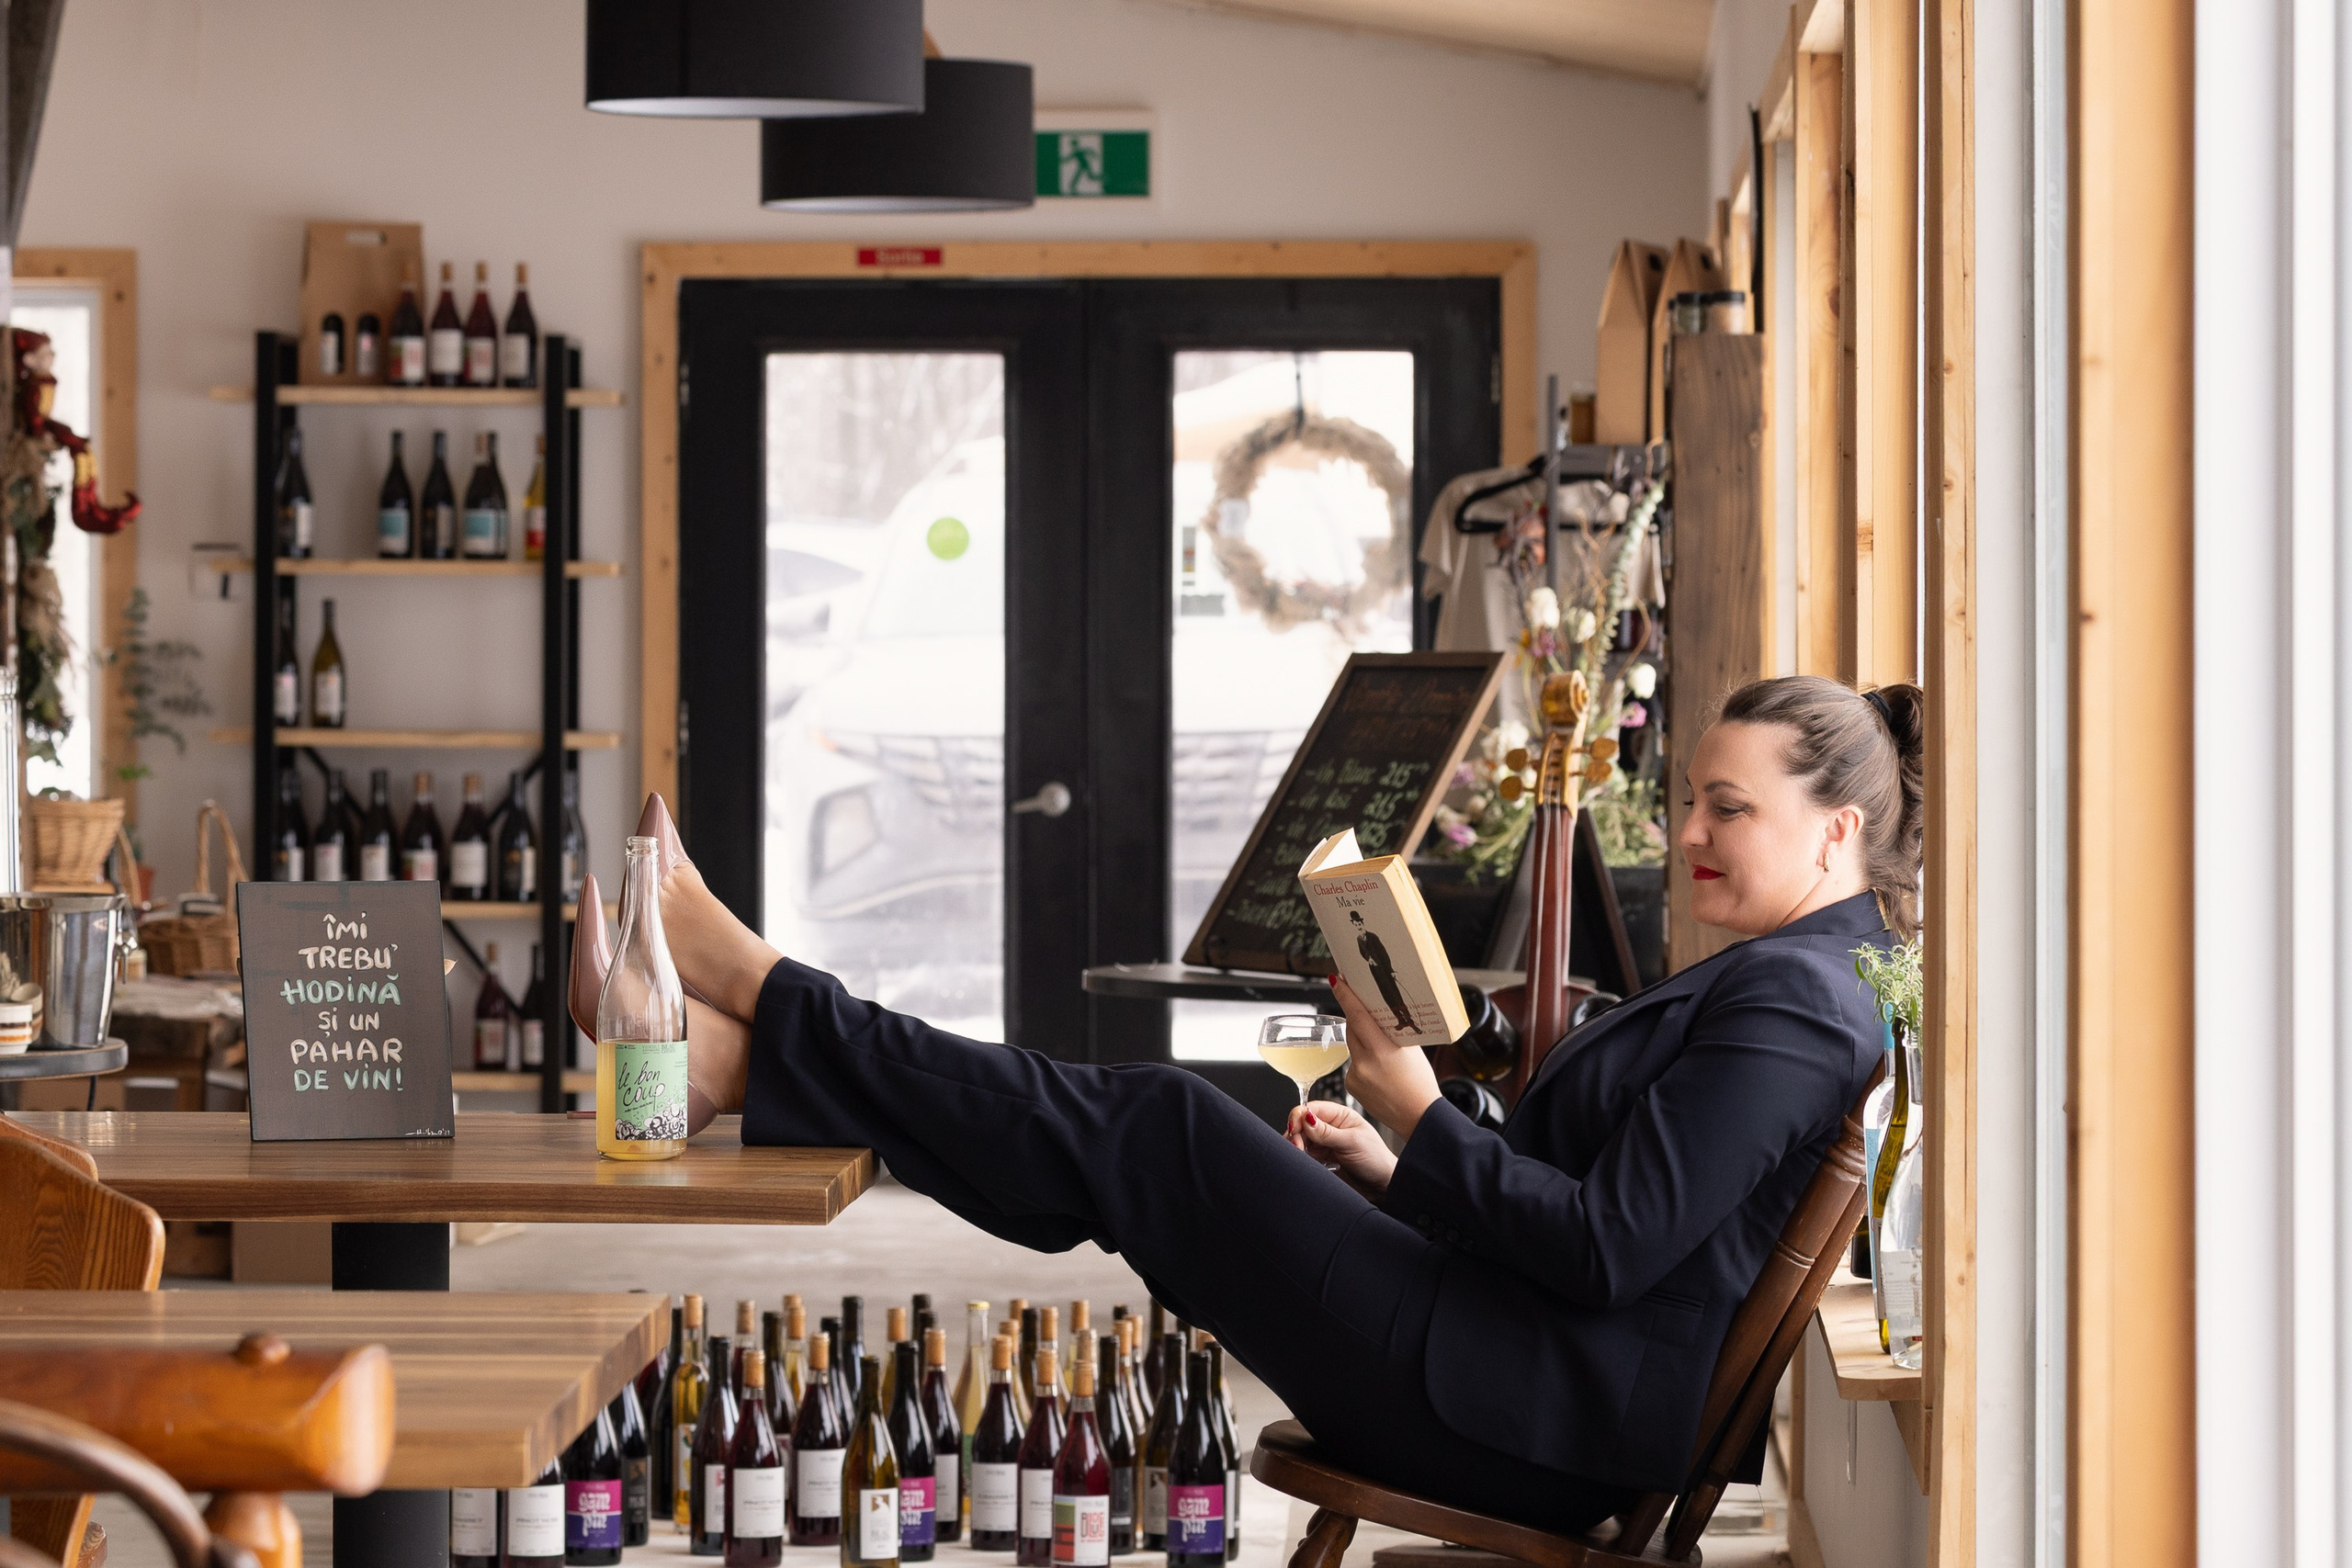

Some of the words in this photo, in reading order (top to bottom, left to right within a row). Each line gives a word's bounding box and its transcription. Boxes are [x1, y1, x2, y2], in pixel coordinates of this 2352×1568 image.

[1313, 882, 1344, 896] Charles
[1344, 878, 1379, 893] Chaplin
[1335, 896, 1351, 908] Ma
[1352, 895, 1365, 906] vie
[349, 1011, 379, 1032] UN
[289, 1037, 404, 1065] PAHAR
[293, 1068, 329, 1092] DE
[634, 1060, 661, 1085] bon
